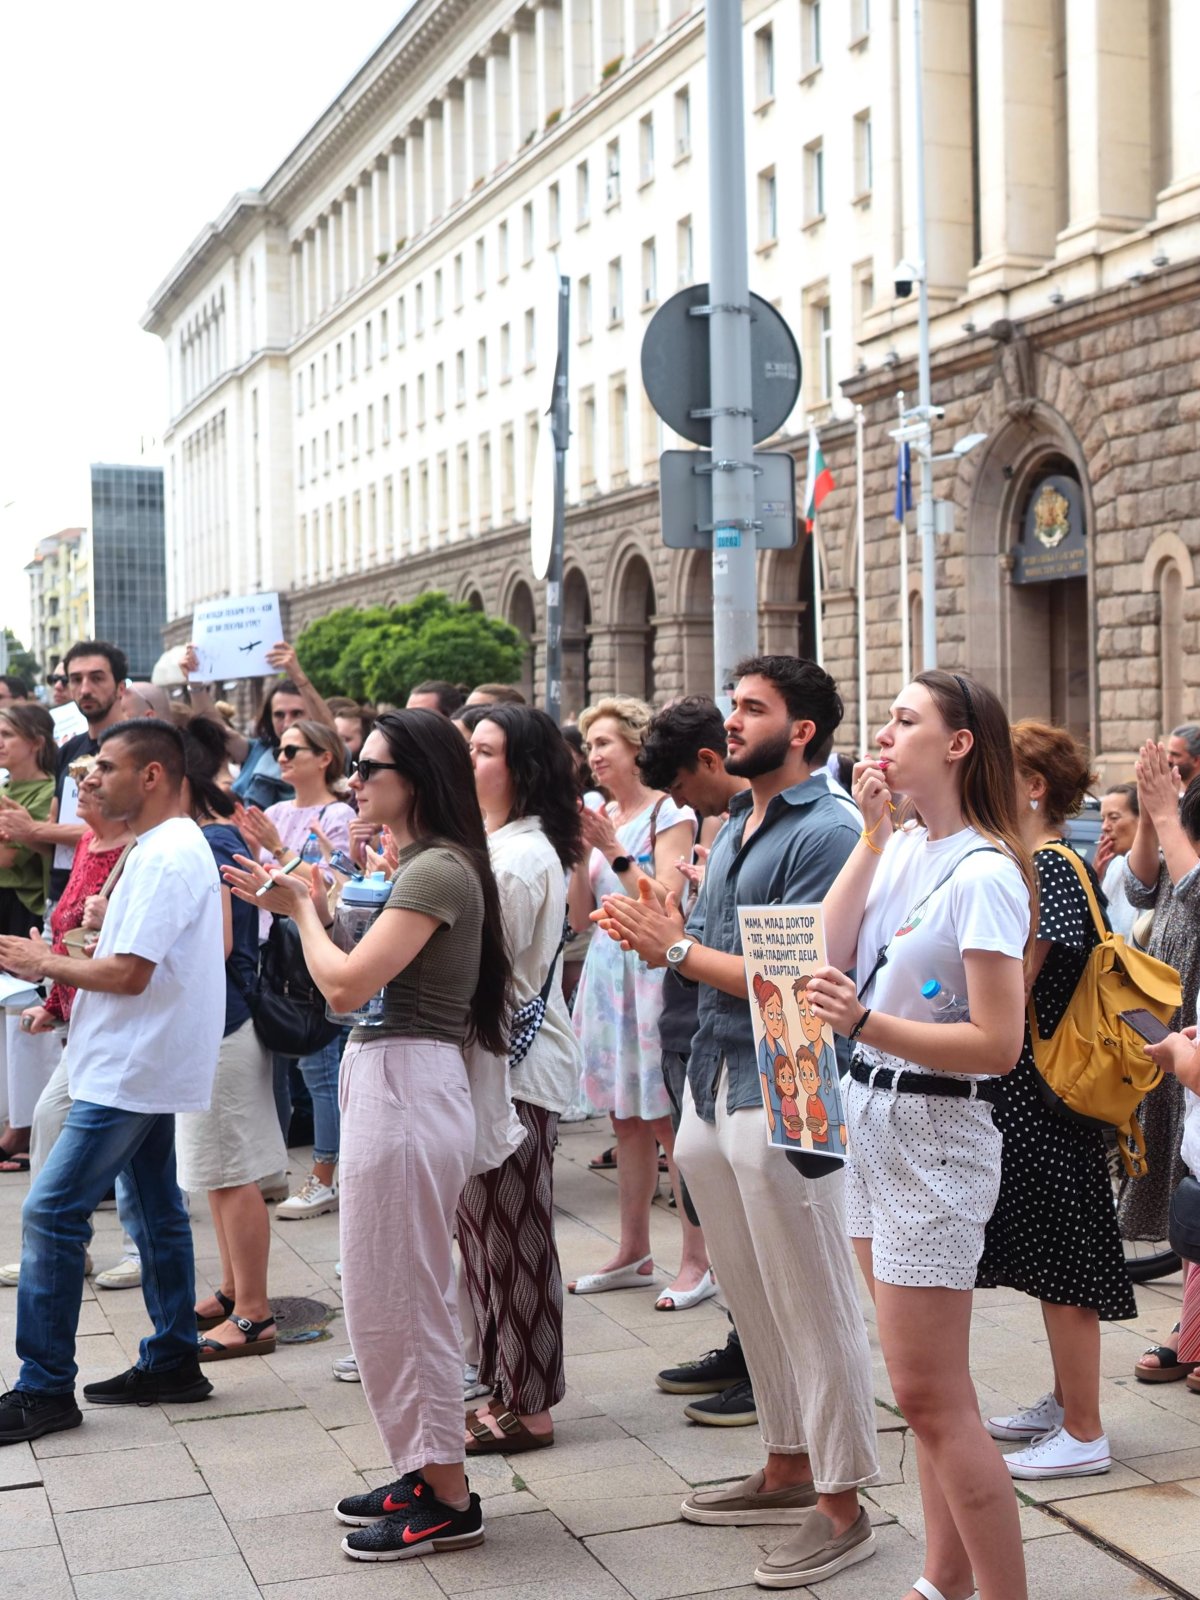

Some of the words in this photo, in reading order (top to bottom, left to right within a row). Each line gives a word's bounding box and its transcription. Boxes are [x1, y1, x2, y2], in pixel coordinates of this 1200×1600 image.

[744, 917, 764, 930] МАМА,
[764, 917, 784, 930] МЛАД
[785, 916, 815, 930] ДОКТОР
[766, 933, 786, 946] МЛАД
[786, 933, 814, 946] ДОКТОР
[752, 947, 797, 962] НАЙ-ГЛАДНИТЕ
[798, 949, 818, 963] ДЕЦА
[764, 965, 768, 976] В
[769, 965, 801, 977] КВАРТАЛА
